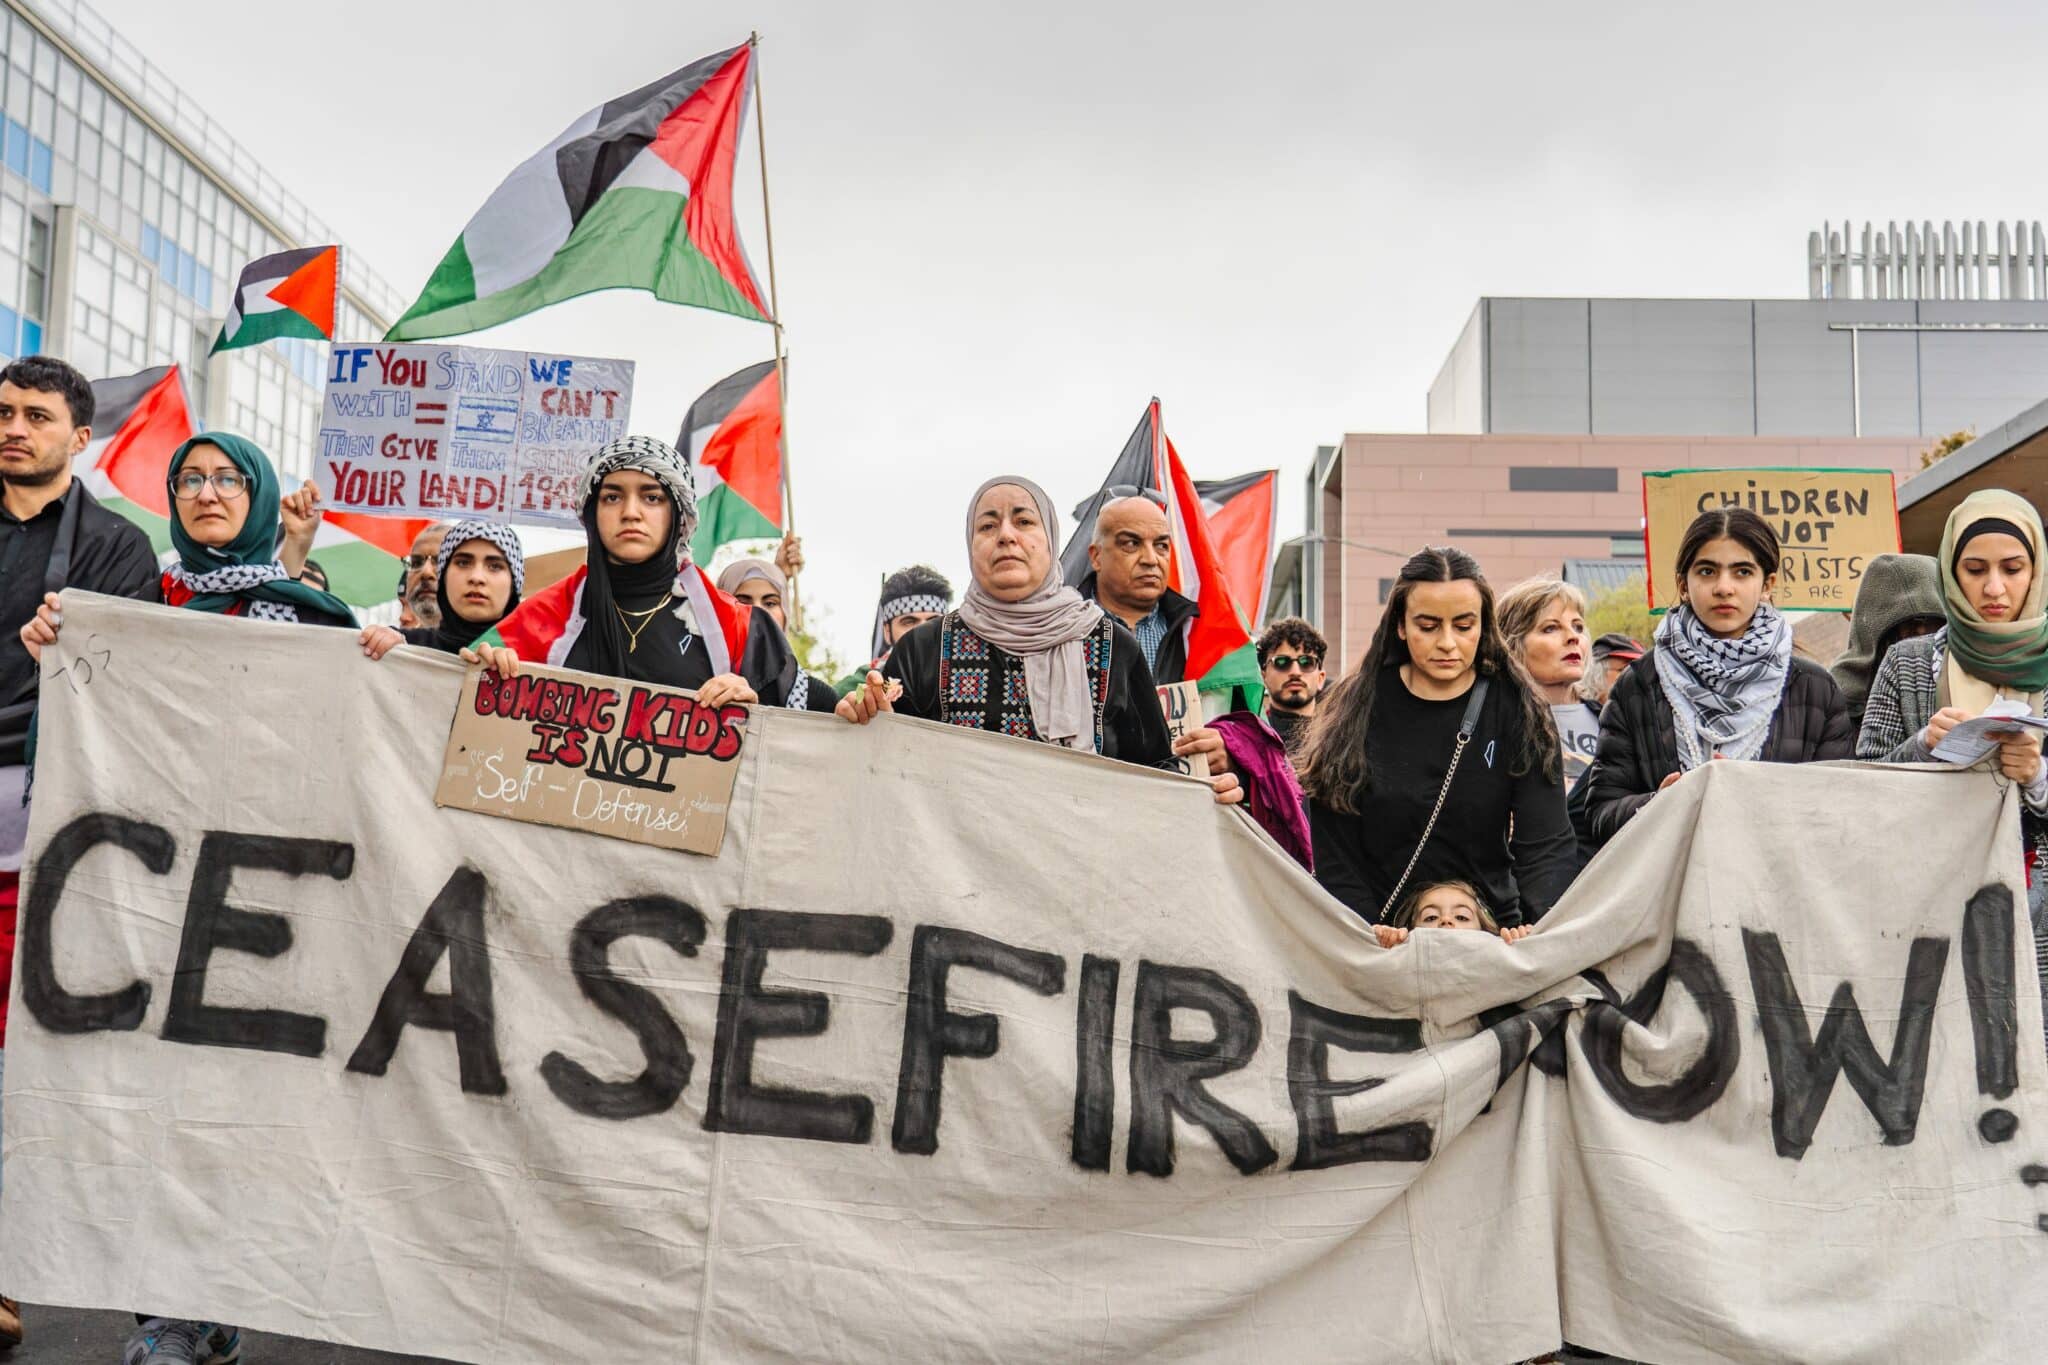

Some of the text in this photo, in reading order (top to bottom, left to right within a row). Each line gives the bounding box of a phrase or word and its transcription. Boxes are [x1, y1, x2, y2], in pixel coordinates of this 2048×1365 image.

[329, 348, 373, 383] IF
[375, 348, 427, 388] YOU
[529, 358, 573, 386] WE
[332, 390, 411, 418] WITH
[540, 386, 620, 419] CAN'T
[320, 429, 506, 471] THEN GIVE THEM
[329, 461, 507, 512] YOUR LAND!
[1808, 585, 1844, 599] ARE
[475, 669, 749, 761] BOMBING KIDS
[526, 724, 686, 788] IS NOT
[21, 812, 1433, 1176] CEASEFIRE
